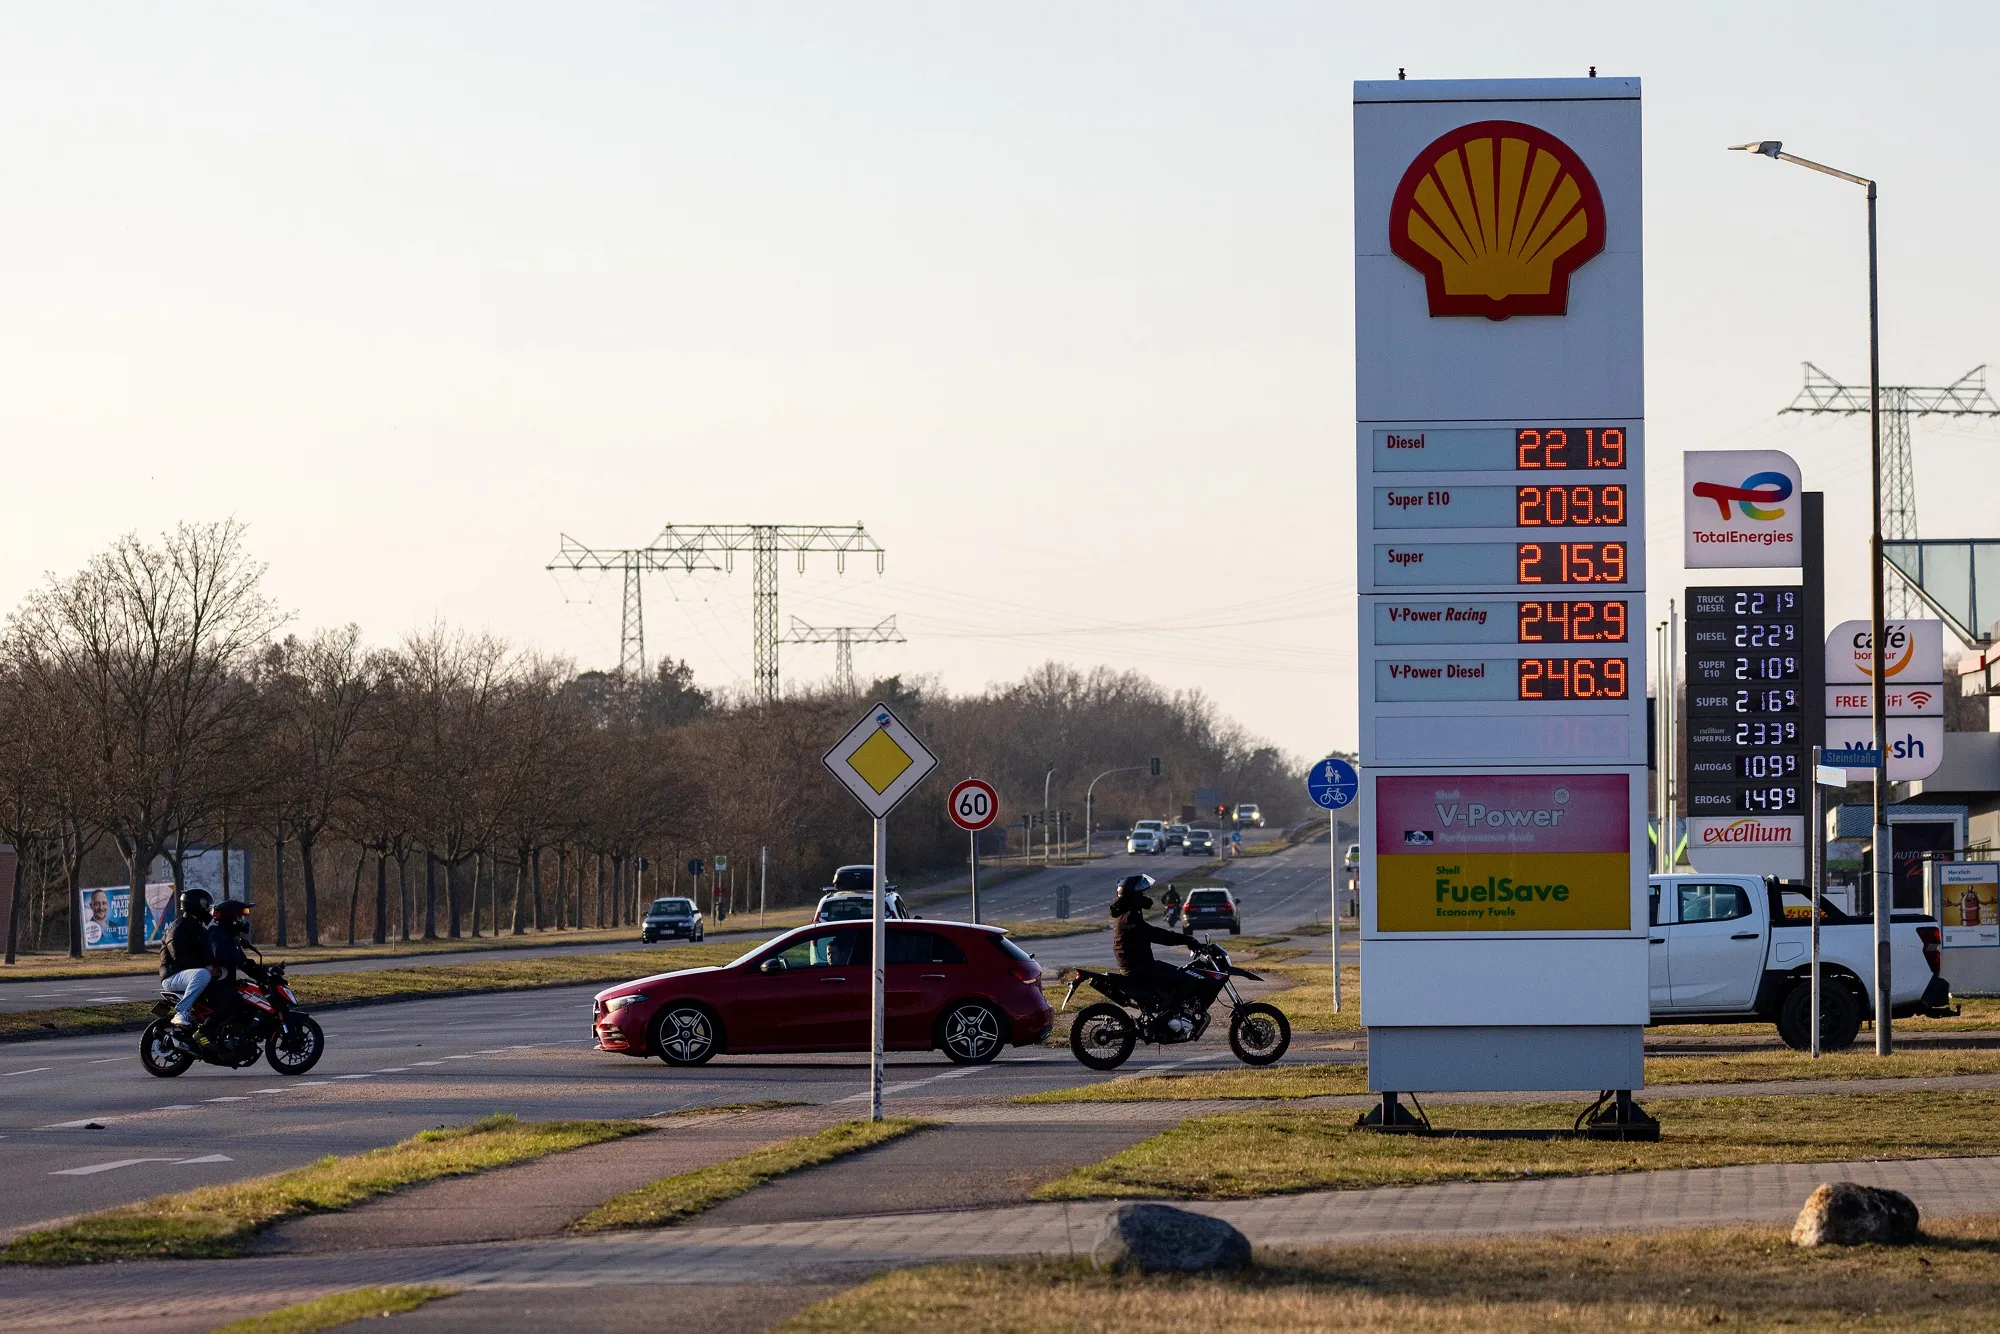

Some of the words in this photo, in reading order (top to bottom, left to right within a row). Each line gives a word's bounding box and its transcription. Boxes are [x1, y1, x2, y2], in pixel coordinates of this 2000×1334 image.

[1387, 434, 1425, 449] Diesel
[1519, 429, 1623, 467] 221.9
[1388, 492, 1423, 510] Super
[1428, 491, 1450, 505] E10
[1519, 486, 1624, 525] 209.9
[1692, 530, 1793, 546] TotalEnergies
[1388, 550, 1424, 567] Super
[1520, 544, 1624, 582] 215.9
[1697, 595, 1725, 603] TRUCK
[1696, 604, 1725, 612] DIESEL
[1389, 608, 1442, 621] V-Power
[1445, 608, 1488, 624] Racing
[1521, 602, 1625, 640] 242.9
[1696, 632, 1727, 640] DIESEL
[1389, 665, 1443, 678] V-Power
[1447, 663, 1485, 678] Diesel
[1699, 661, 1725, 669] SUPER
[1521, 659, 1625, 698] 246.9
[1696, 697, 1728, 706] SUPER
[1836, 696, 1868, 707] FREE
[1827, 752, 1876, 764] Steinstraße
[1694, 763, 1732, 771] AUTOGAS
[1435, 790, 1460, 799] Shell
[1694, 795, 1731, 804] ERDGAS
[960, 794, 987, 816] 60
[1435, 803, 1564, 827] V-Power
[1704, 823, 1792, 842] excellium
[1436, 866, 1460, 875] Shell
[1436, 877, 1570, 902] FuelSave
[1436, 908, 1485, 918] Economy
[1488, 907, 1516, 916] Fuels
